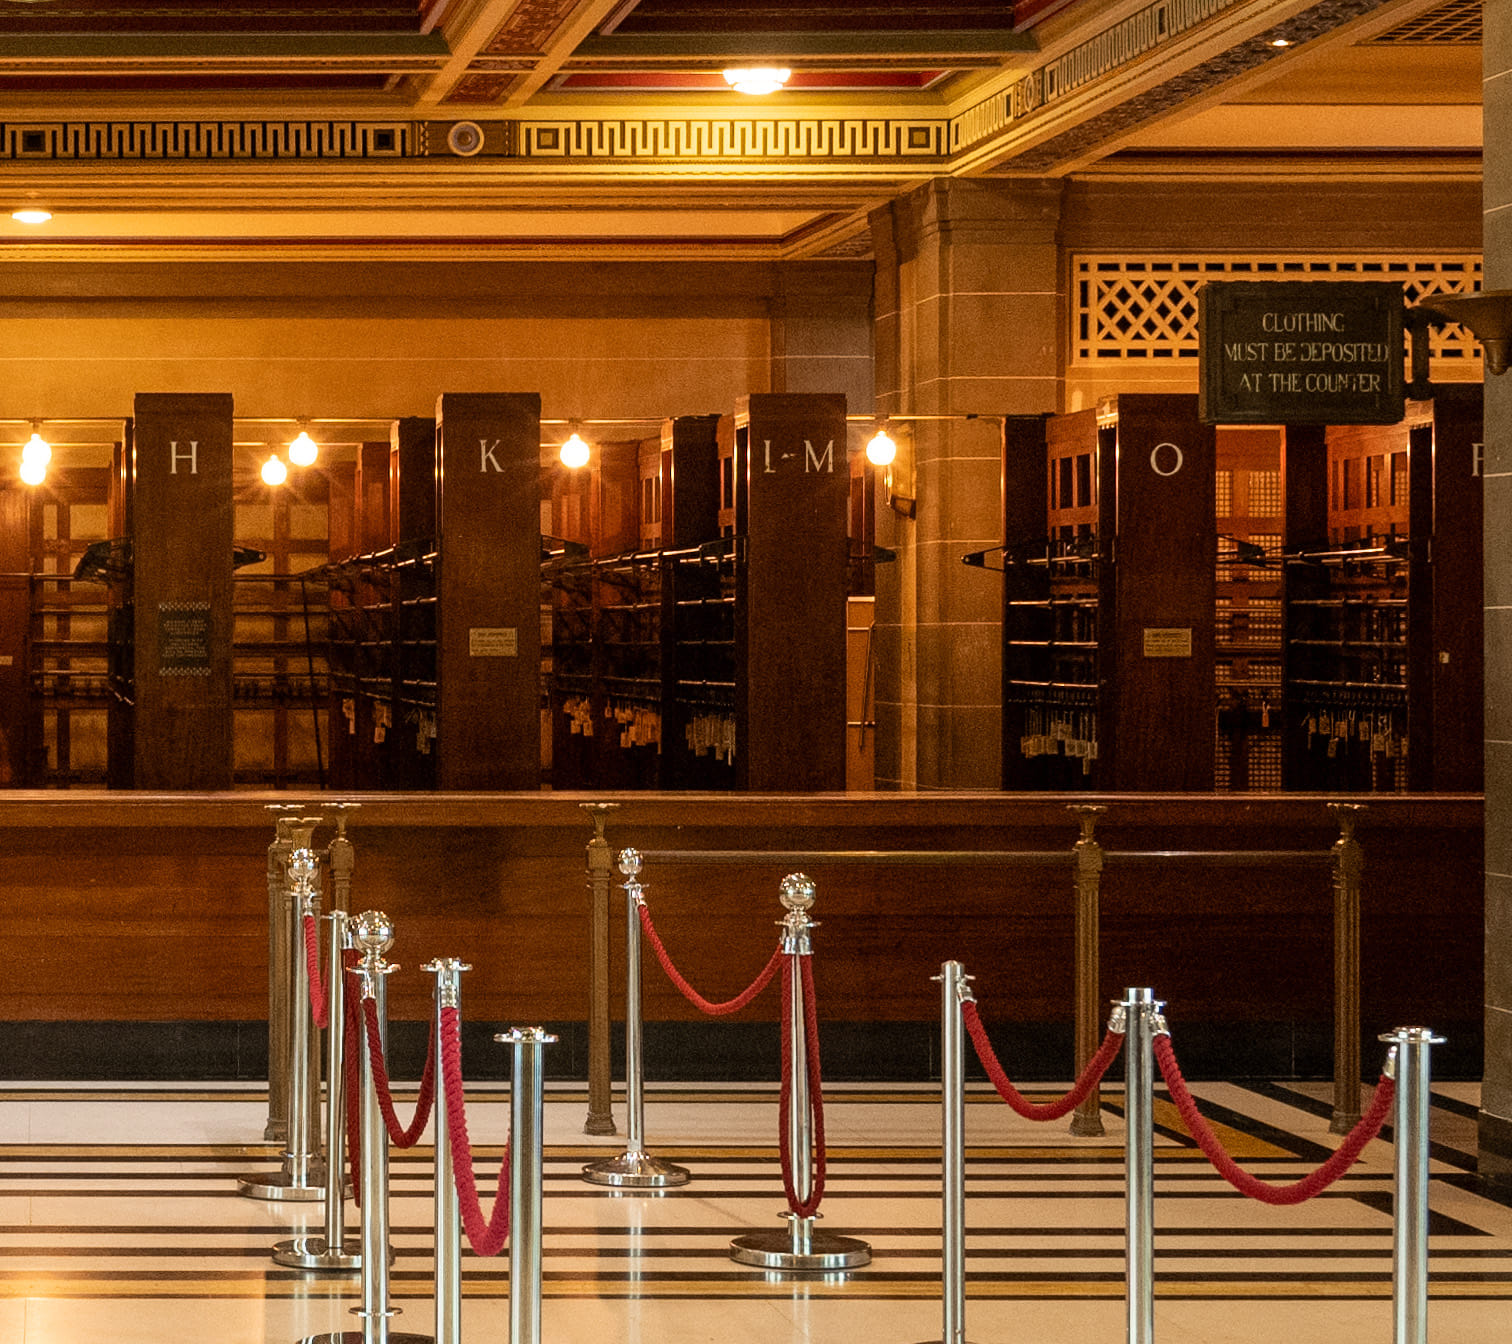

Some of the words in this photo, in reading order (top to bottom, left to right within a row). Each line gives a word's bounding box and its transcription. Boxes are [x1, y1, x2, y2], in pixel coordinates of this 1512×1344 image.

[1261, 312, 1345, 333] CLOTHING
[1224, 342, 1269, 362] MUST
[1274, 342, 1296, 362] BE
[1300, 342, 1390, 363] DEPOSITED
[1239, 372, 1263, 393] AT
[1268, 372, 1301, 393] THE
[1305, 372, 1381, 393] COUNTER
[169, 441, 199, 475] H
[479, 439, 505, 473] K
[1149, 442, 1184, 477] O
